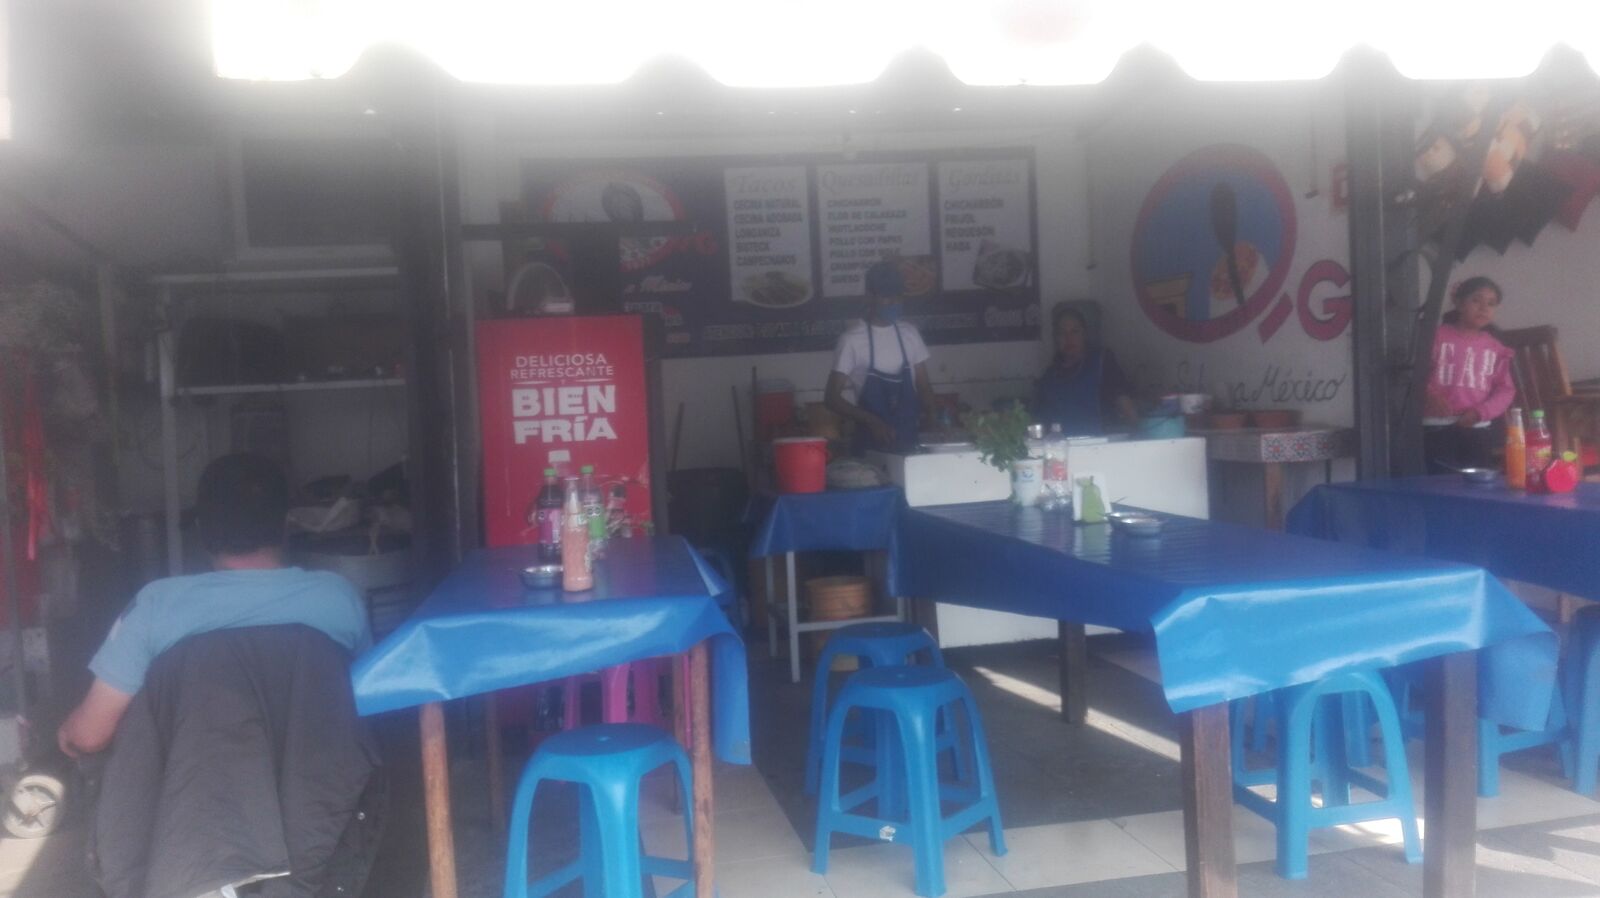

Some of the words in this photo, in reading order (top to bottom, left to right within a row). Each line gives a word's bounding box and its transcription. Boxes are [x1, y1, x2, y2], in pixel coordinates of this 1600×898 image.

[734, 173, 797, 193] Tacos
[735, 199, 763, 209] CECINA
[767, 199, 802, 209] NATURAL
[735, 213, 764, 224] CECINA
[767, 212, 803, 223] ADOBADA
[828, 211, 849, 221] FLOR
[851, 211, 863, 221] DE
[864, 209, 907, 219] CALABAZA
[736, 227, 781, 238] LONGANIZA
[829, 237, 856, 247] POLLO
[858, 236, 876, 245] CON
[877, 235, 903, 245] PAPAS
[829, 249, 857, 259] POLLO
[858, 248, 876, 258] CON
[515, 353, 608, 368] DELICIOSA
[1437, 342, 1497, 392] GAP
[510, 365, 615, 380] REFRESCANTE
[1251, 366, 1347, 403] México
[512, 385, 616, 417] BIEN
[513, 415, 618, 444] FRÍA
